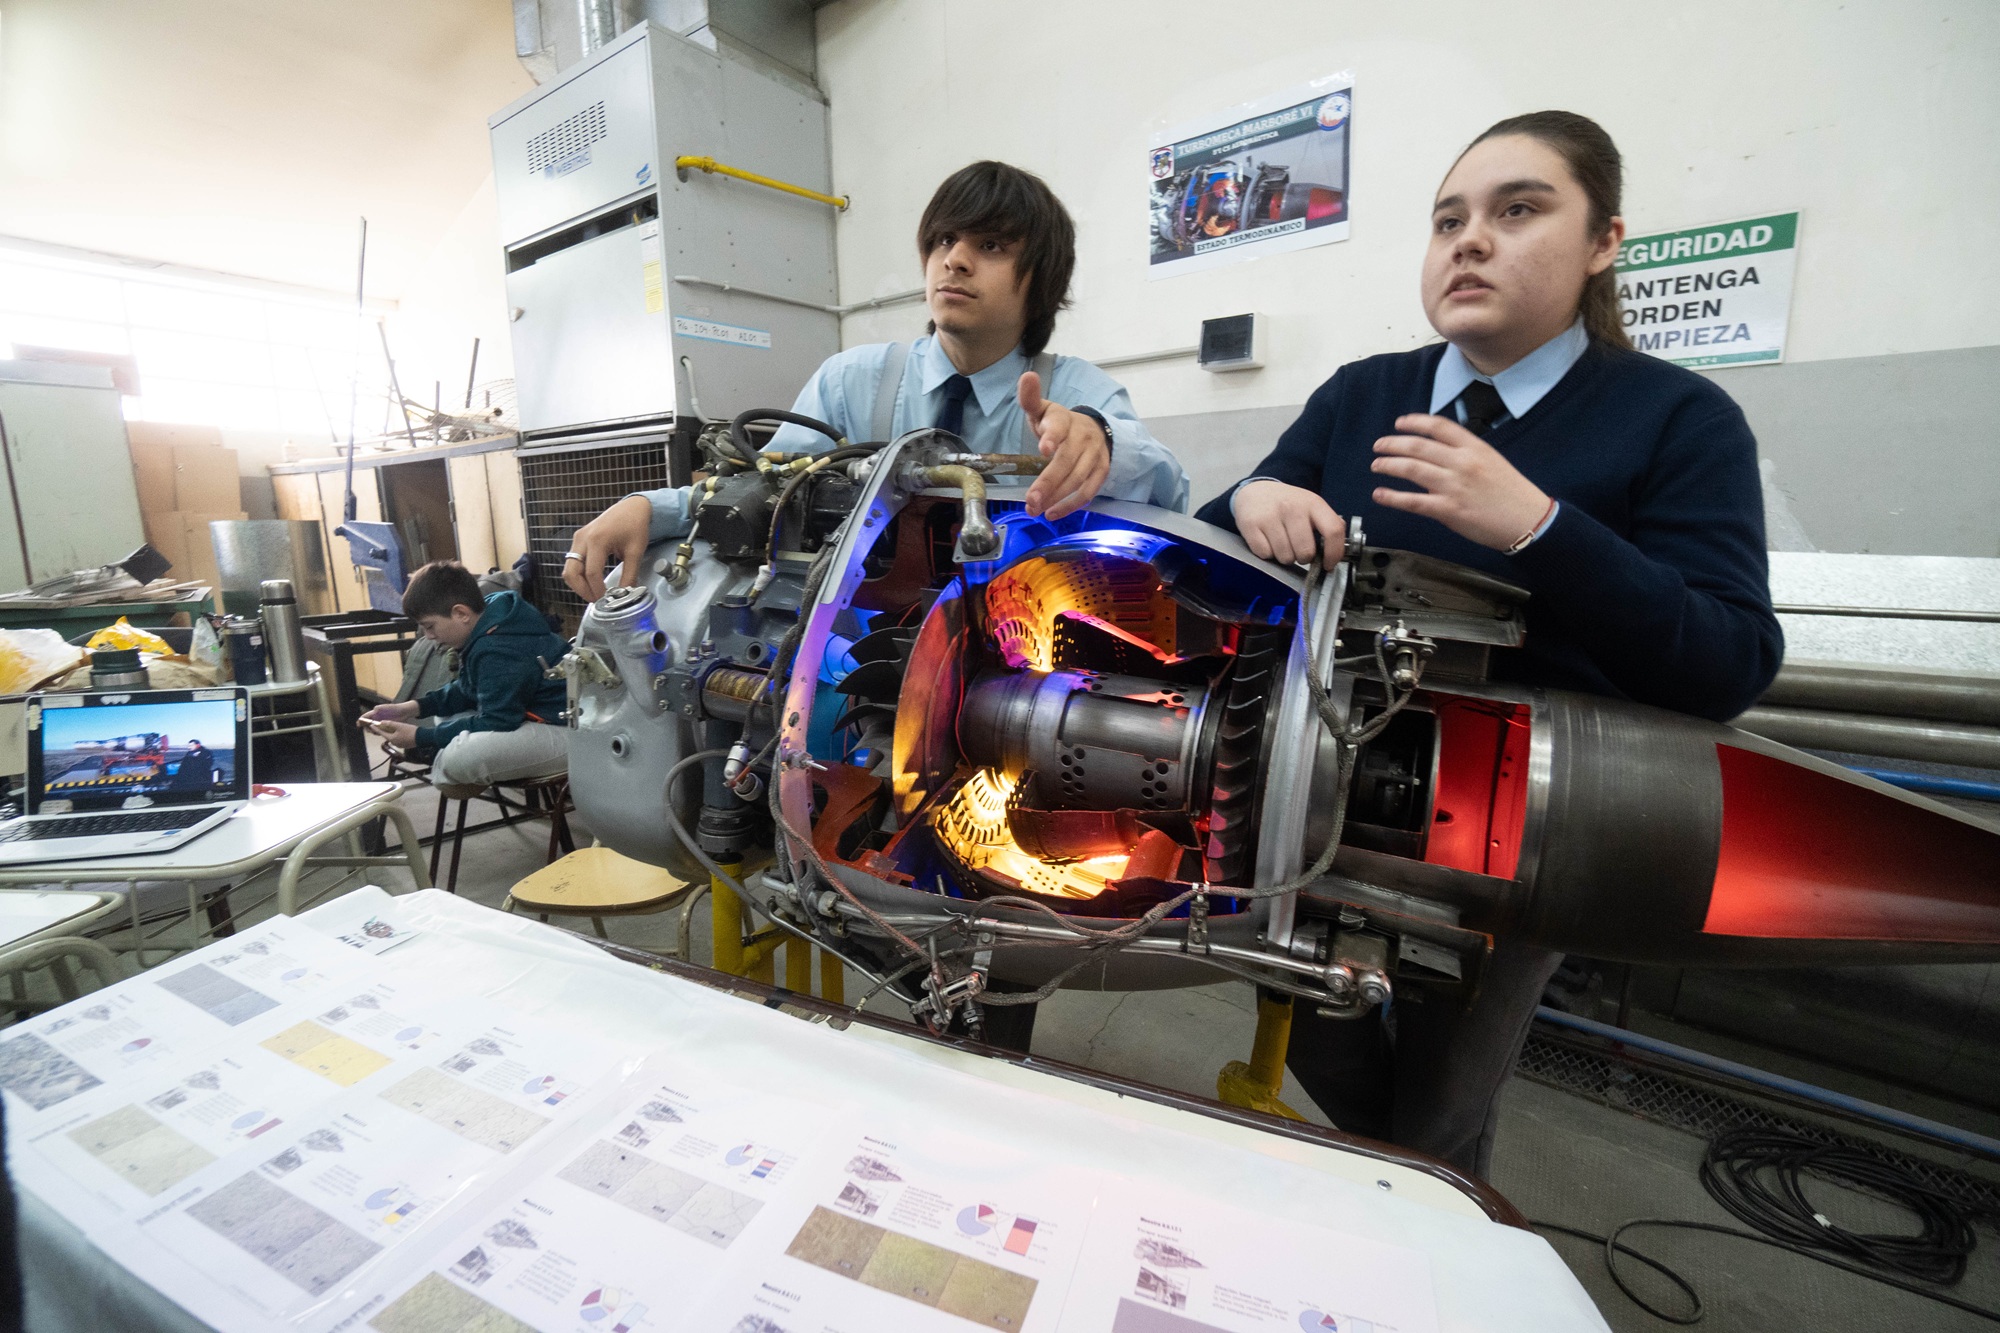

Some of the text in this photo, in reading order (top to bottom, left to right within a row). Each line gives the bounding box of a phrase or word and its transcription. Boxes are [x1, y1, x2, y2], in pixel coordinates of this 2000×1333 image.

[1178, 129, 1240, 155] TURBOMECA
[1241, 110, 1298, 136] MARBORÉ
[1299, 105, 1313, 118] VI
[1197, 221, 1302, 251] ESTADO TERMODINÁMICO
[1613, 225, 1774, 267] EGURIDAD
[1618, 267, 1760, 301] ANTENGA
[1621, 299, 1722, 328] ORDEN
[1631, 323, 1751, 351] IMPIEZA
